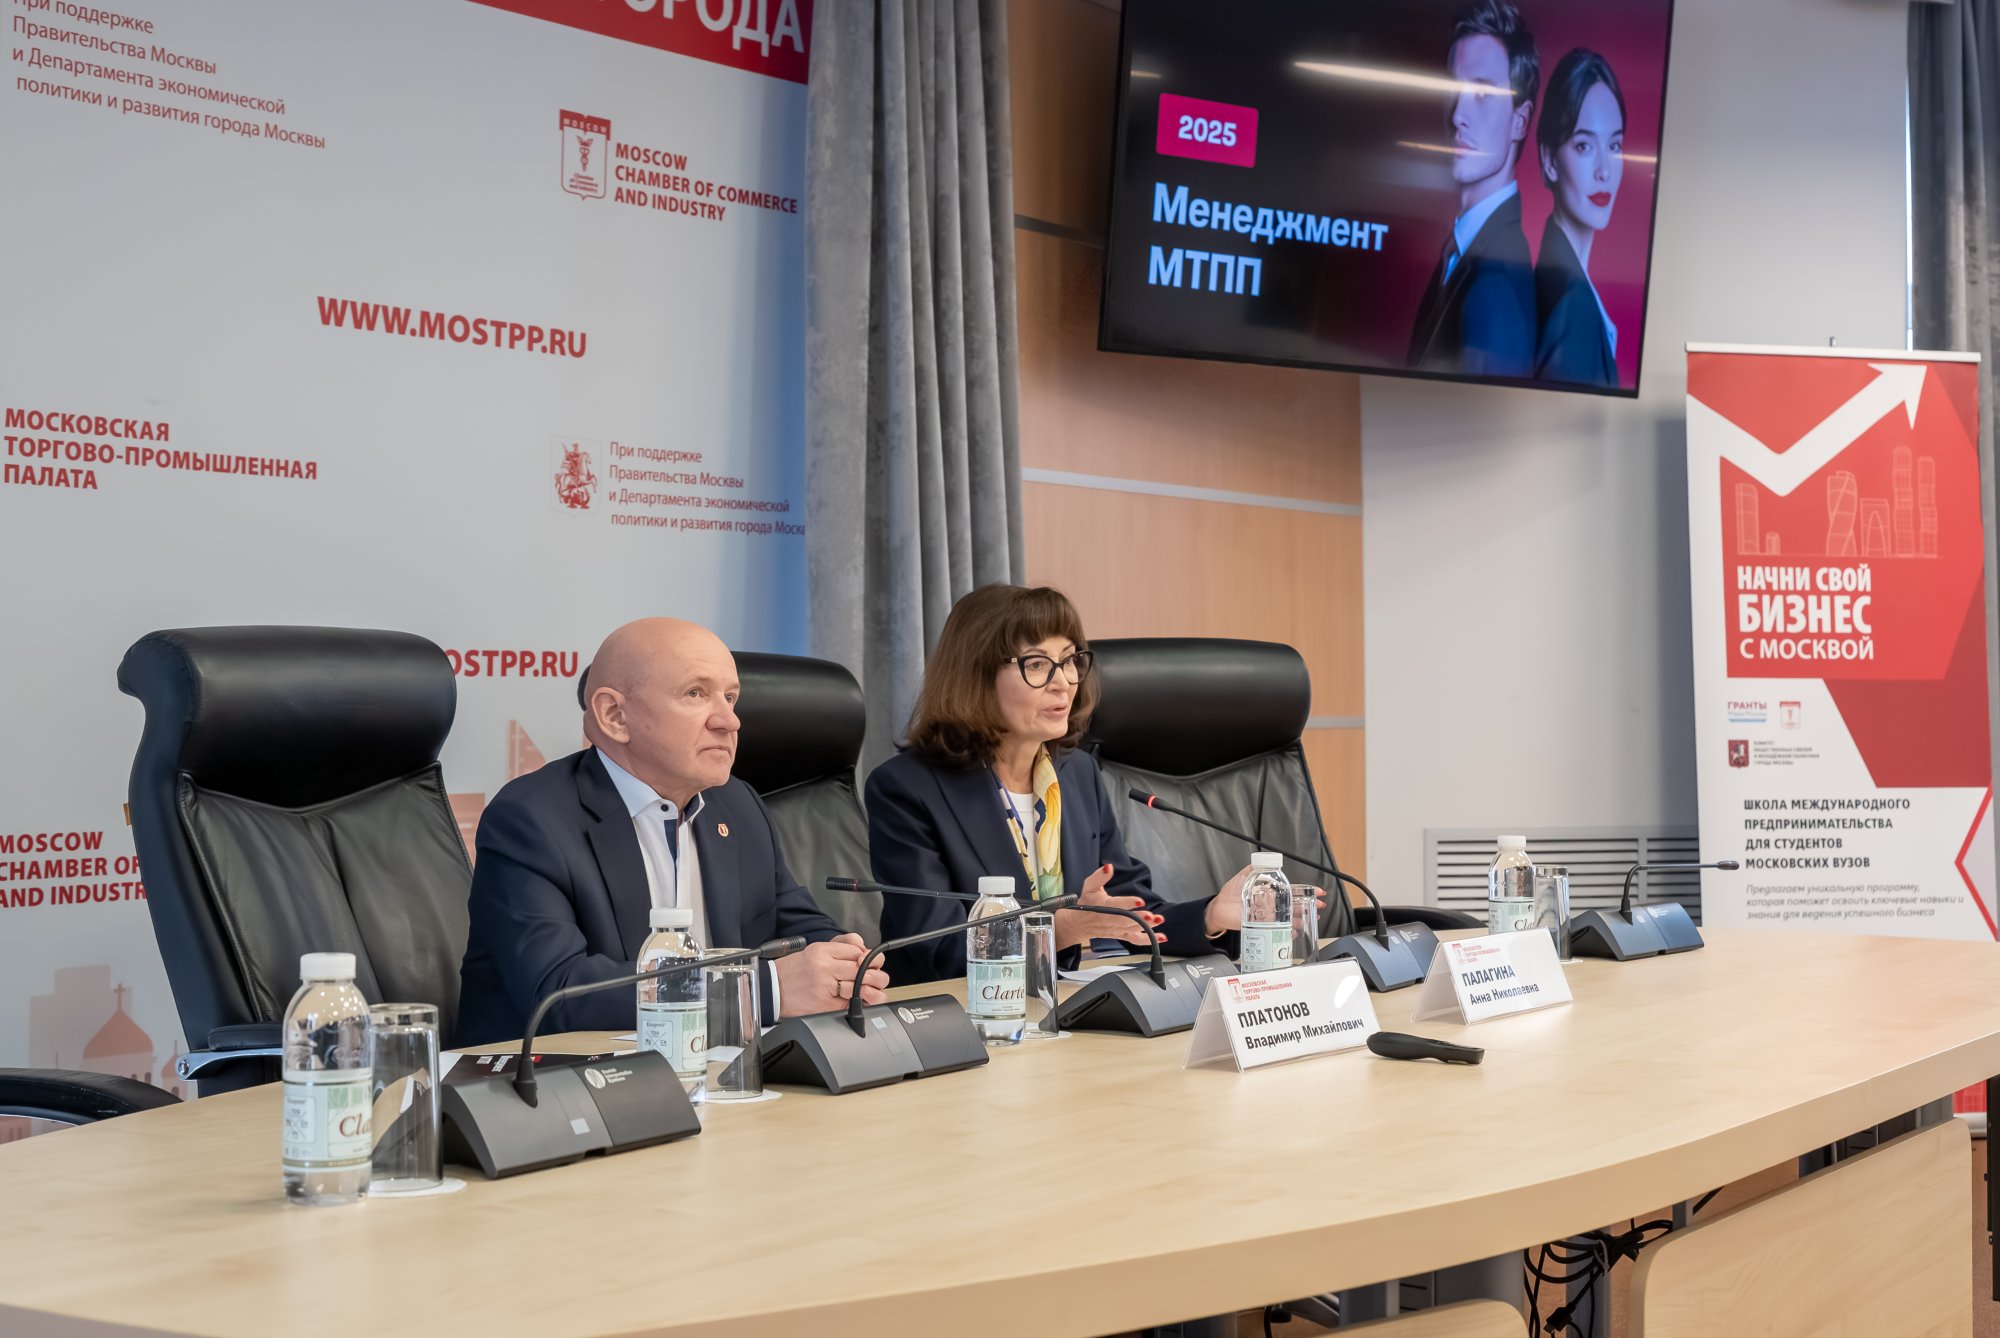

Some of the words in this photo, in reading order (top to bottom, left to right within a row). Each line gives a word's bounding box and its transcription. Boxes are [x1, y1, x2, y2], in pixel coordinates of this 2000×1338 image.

[14, 0, 50, 11] ри
[55, 1, 154, 34] поддержке
[624, 0, 804, 57] ОДА
[13, 15, 146, 60] Правительства
[150, 45, 217, 75] Москвы
[13, 48, 24, 62] и
[28, 47, 154, 89] Департамента
[158, 77, 286, 115] экономической
[17, 77, 102, 106] политики
[107, 95, 118, 109] и
[122, 98, 200, 125] развития
[204, 114, 260, 138] города
[264, 122, 326, 149] Москвы
[1178, 115, 1237, 147] 2025
[615, 142, 687, 171] MOSCOW
[615, 165, 690, 194] CHAMBER
[694, 180, 714, 198] OF
[717, 184, 798, 214] COMMERCE
[614, 187, 648, 207] AND
[652, 195, 726, 221] INDUSTRY
[1153, 182, 1389, 251] Менеджмент
[1148, 245, 1262, 297] МТПП
[317, 296, 587, 358] WWW.MOSTPP.RU
[4, 408, 170, 442] МОСКОВСКАЯ
[4, 435, 318, 480] ТОРГОВО-ПРОМЫШЛЕННАЯ
[610, 442, 634, 459] При
[637, 447, 702, 464] поддержке
[3, 463, 98, 490] ПАЛАТА
[609, 465, 697, 485] Правительства
[700, 471, 744, 488] Москвы
[608, 491, 616, 502] и
[618, 489, 702, 508] Департамента
[704, 498, 790, 513] экономической
[611, 513, 667, 528] политики
[670, 518, 678, 529] и
[680, 518, 732, 532] развития
[735, 521, 772, 535] города
[1737, 565, 1811, 591] НАЧНИ
[1816, 563, 1872, 592] СВОЙ
[1738, 594, 1872, 634] БИЗНЕС
[1739, 638, 1755, 659] С
[1759, 636, 1874, 660] МОСКВОЙ
[1728, 701, 1767, 710] ГРАНТЫ
[1744, 799, 1787, 810] ШКОЛА
[1791, 798, 1911, 811] МЕЖДУНАРОДНОГО
[1744, 818, 1893, 831] ПРЕДПРИНИМАТЕЛЬСТВА
[0, 831, 103, 854] MOSCOW
[1745, 839, 1771, 851] ДЛЯ
[1774, 838, 1843, 850] СТУДЕНТОВ
[0, 857, 108, 881] CHAMBER
[1745, 857, 1829, 869] МОСКОВСКИХ
[1833, 857, 1870, 869] ВУЗОВ
[0, 887, 44, 908] AND
[1461, 964, 1516, 987] ПАЛАГИНА
[1469, 993, 1492, 1005] Анна
[1492, 982, 1540, 1000] Николаевна
[1237, 1002, 1311, 1028] ПЛАТОНОВ
[1245, 1030, 1302, 1050] Владимир
[1304, 1018, 1365, 1039] Михайлович
